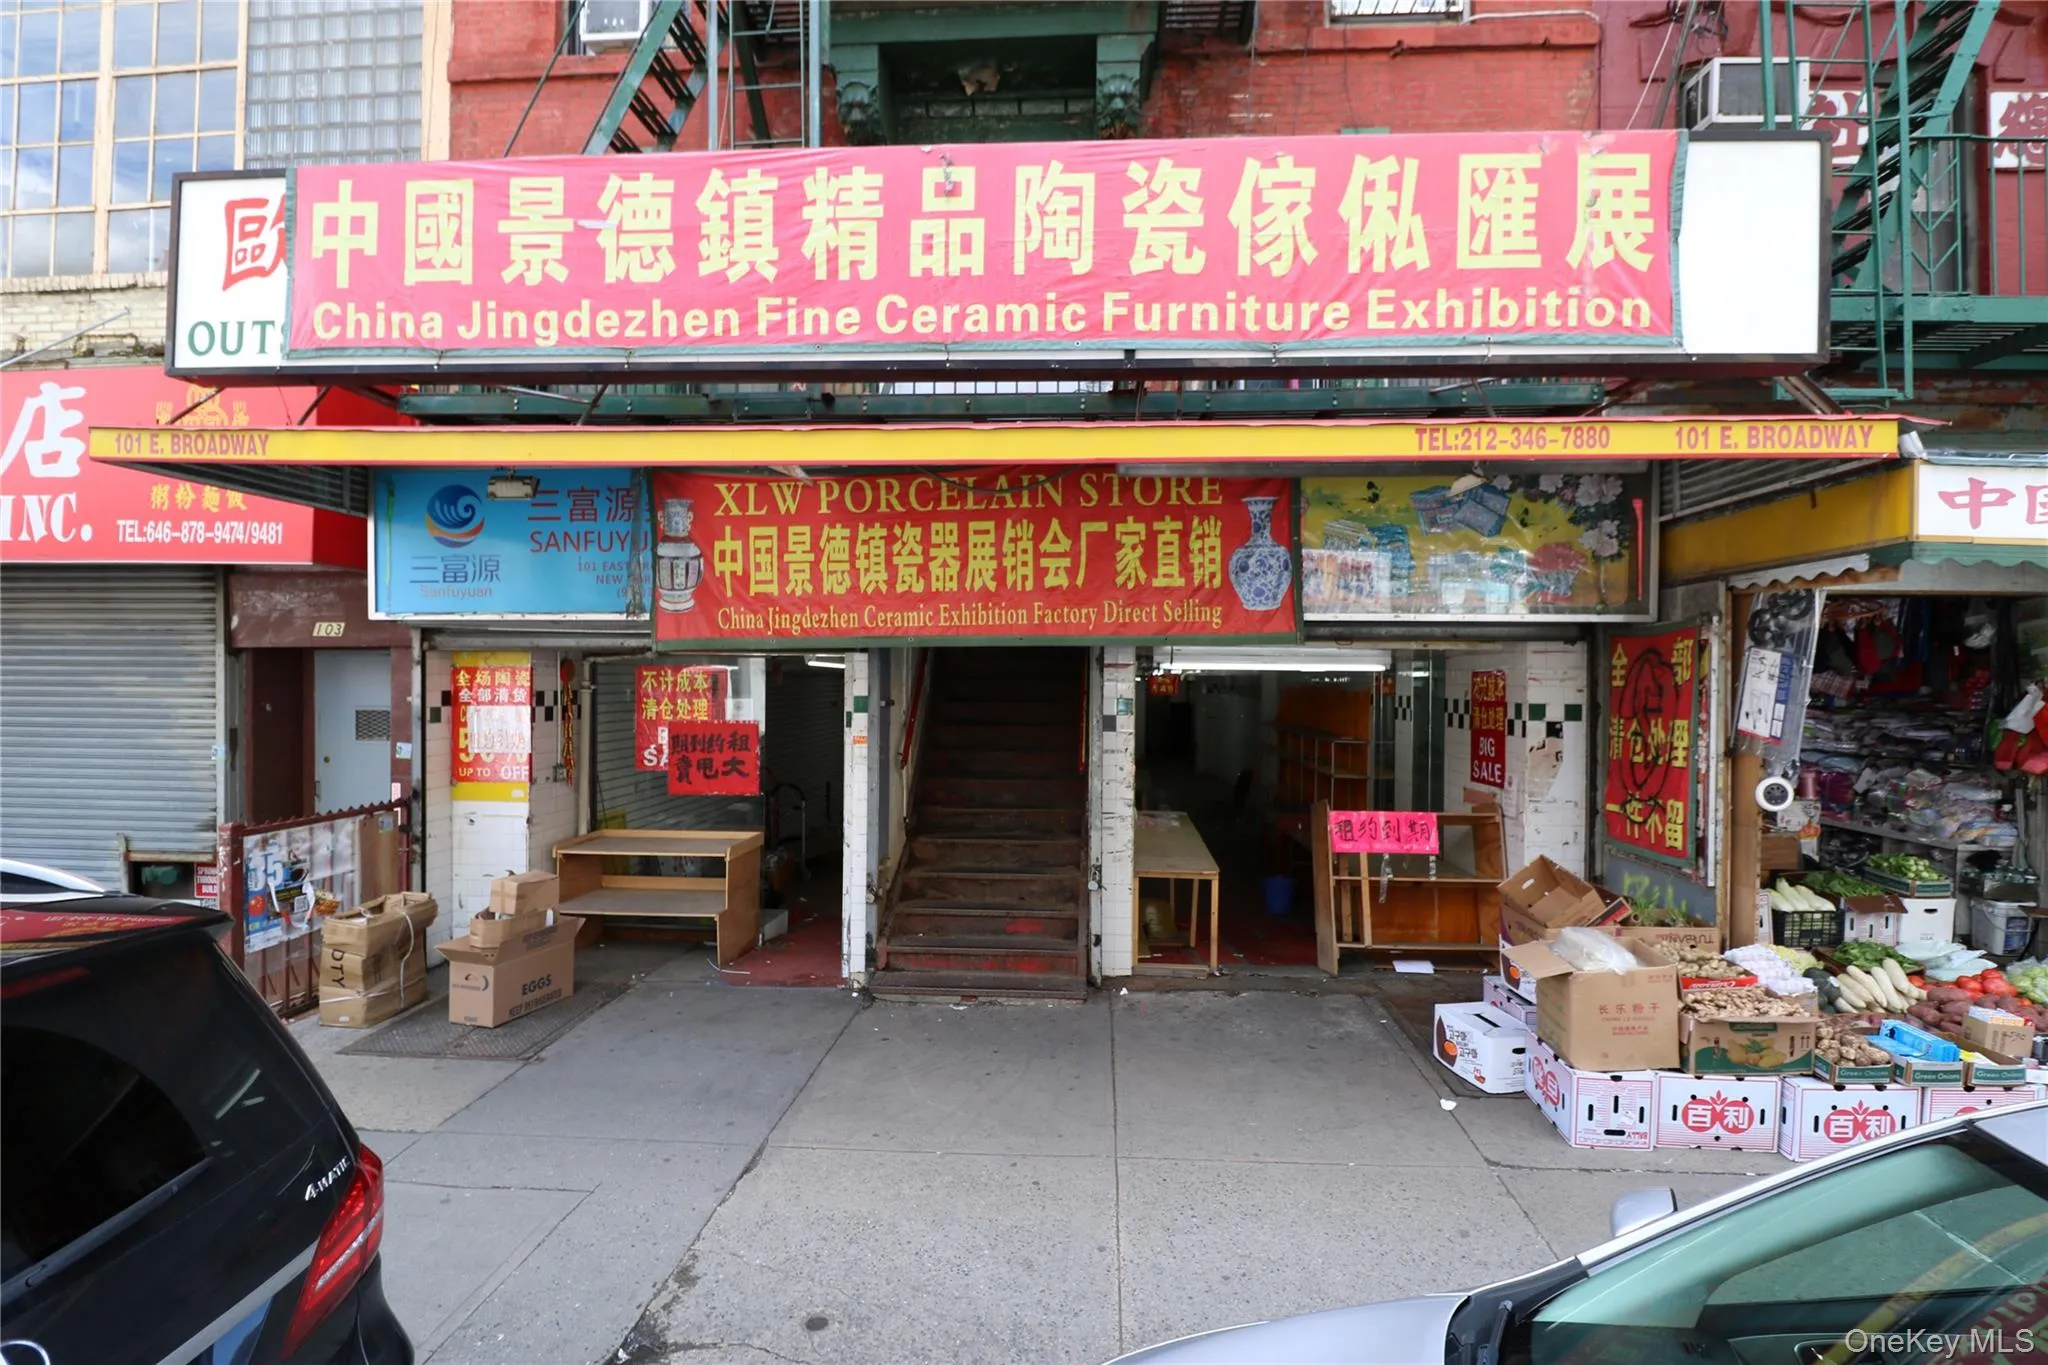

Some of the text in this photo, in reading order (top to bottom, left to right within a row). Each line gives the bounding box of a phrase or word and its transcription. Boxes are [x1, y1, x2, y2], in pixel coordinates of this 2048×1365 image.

[312, 153, 1655, 289] 中國景德鎮精品陶瓷傢俬匯展
[314, 287, 1651, 347] China Jingdezhen Fine Ceramic Furniture Exhibition
[187, 319, 284, 357] OUT
[0, 381, 86, 478] 店
[1415, 426, 1611, 451] TEL:212-346-7880
[1676, 424, 1874, 450] 101 E. BROADWAY
[115, 434, 270, 455] 101 E. BROADWAY
[714, 473, 1223, 516] XLW PORCELAIN STORE
[0, 492, 92, 544] INC.
[117, 519, 284, 545] TEL:646-878-9474/9481
[410, 553, 500, 584] 三富源
[714, 515, 1223, 597] 中国景德镇瓷器展销会厂家直销
[420, 584, 493, 599] Sanfuyuan
[316, 624, 342, 635] 103
[717, 599, 1223, 636] China Jingdezhen Ceramic Exhibition Factory Direct Selling
[642, 695, 709, 720] 清仓处理
[1479, 736, 1496, 758] BIG
[459, 765, 529, 780] UP TO OFF
[1472, 760, 1503, 783] SALE
[331, 949, 347, 989] DTY
[522, 973, 552, 996] EGGS
[1687, 1104, 1749, 1129] 百利
[1829, 1115, 1891, 1138] 百利
